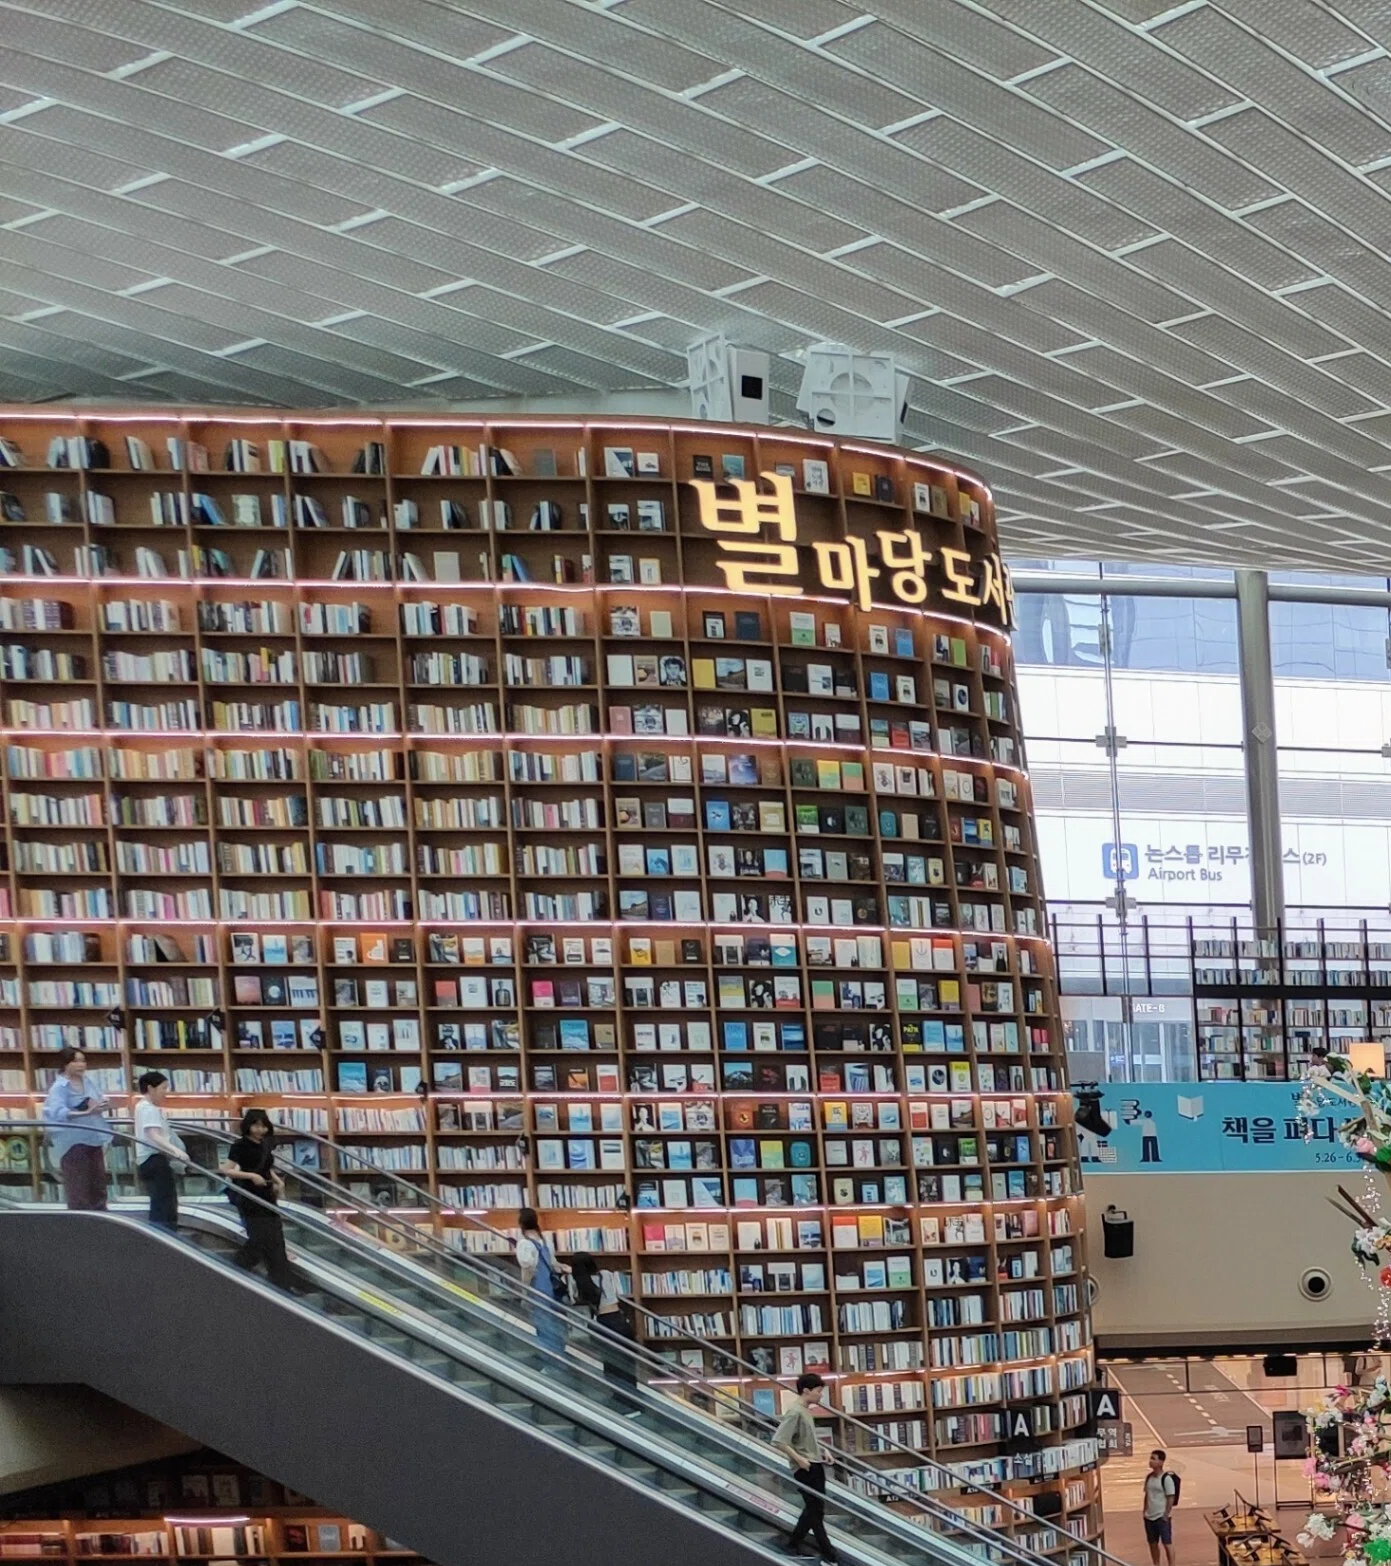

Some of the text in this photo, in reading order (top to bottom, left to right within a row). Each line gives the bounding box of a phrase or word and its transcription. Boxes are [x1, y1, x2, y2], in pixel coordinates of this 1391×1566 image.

[1144, 844, 1203, 865] 논스톱
[1147, 867, 1223, 882] Airport Bus
[1222, 1116, 1277, 1143] 책을
[1097, 1394, 1116, 1416] A
[1014, 1413, 1030, 1437] A
